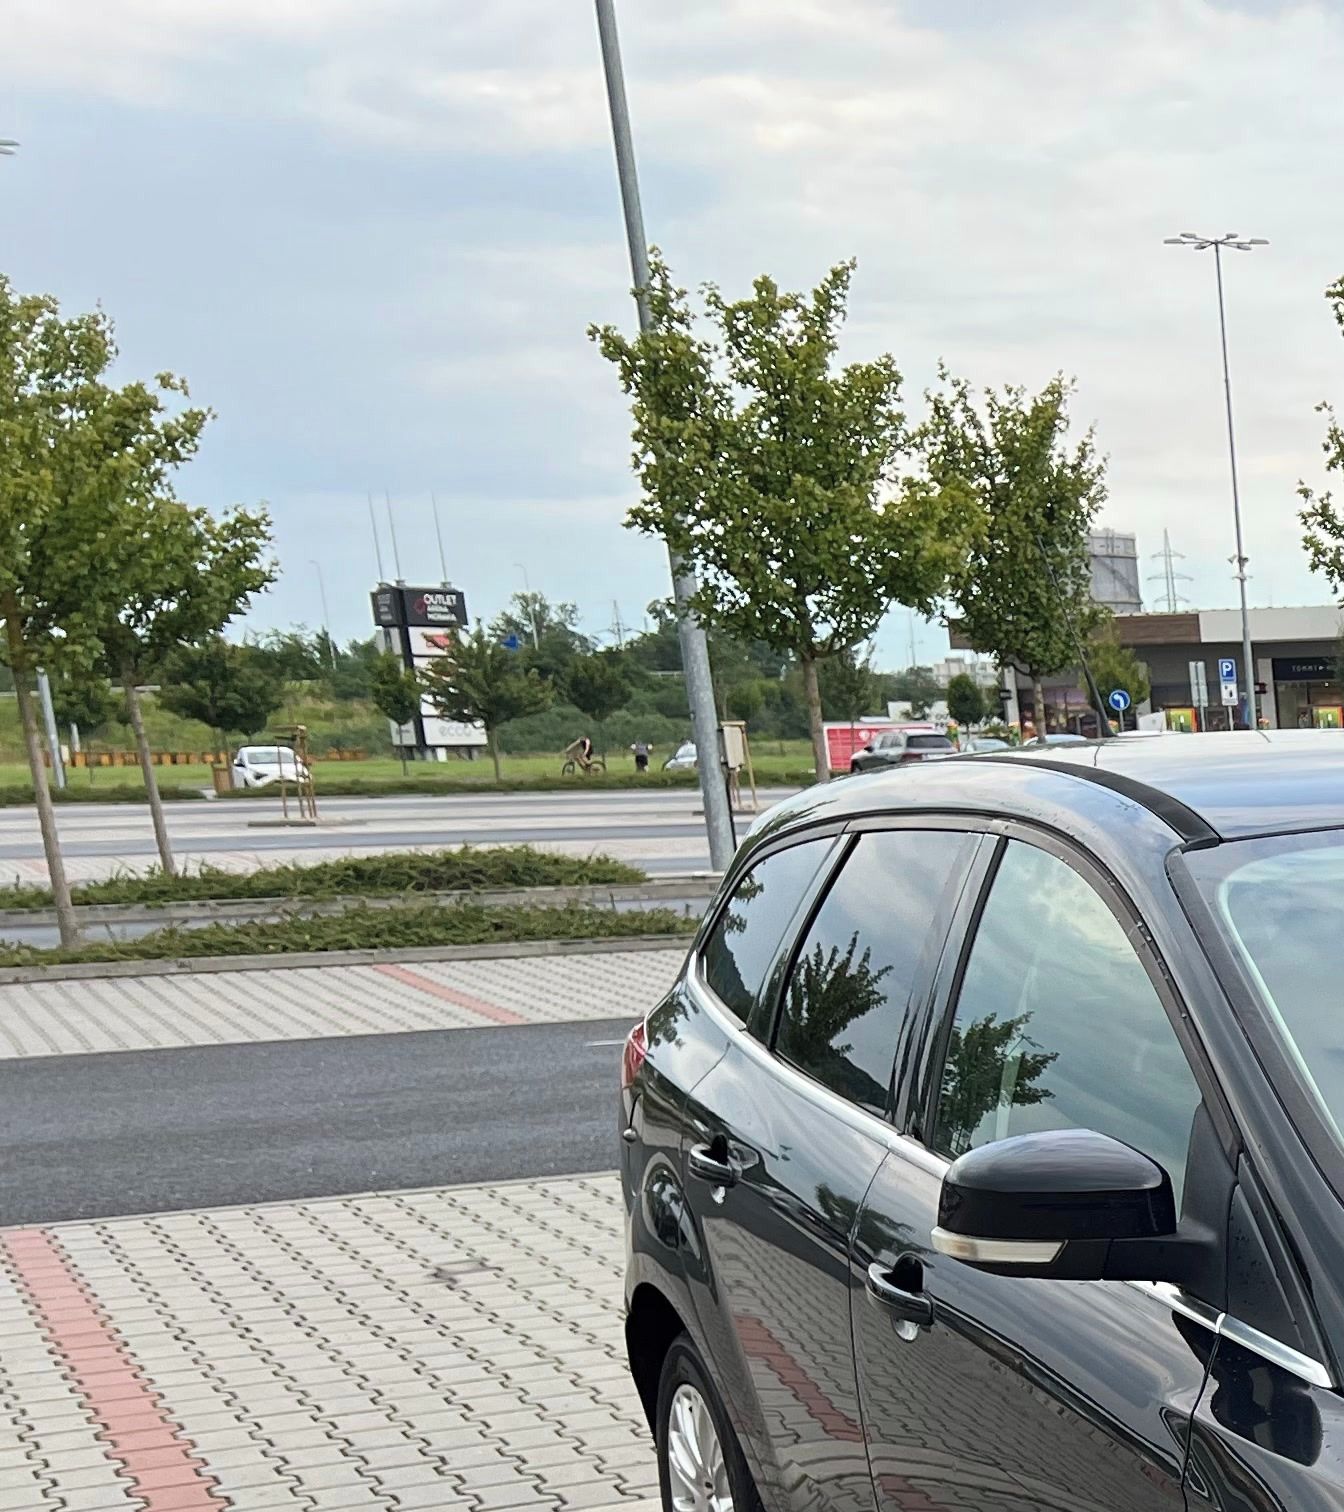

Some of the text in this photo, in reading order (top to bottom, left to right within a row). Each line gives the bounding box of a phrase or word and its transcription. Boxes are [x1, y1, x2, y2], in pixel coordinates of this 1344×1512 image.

[423, 594, 457, 605] OUTLET
[1222, 662, 1232, 677] P
[439, 725, 472, 736] ecco
